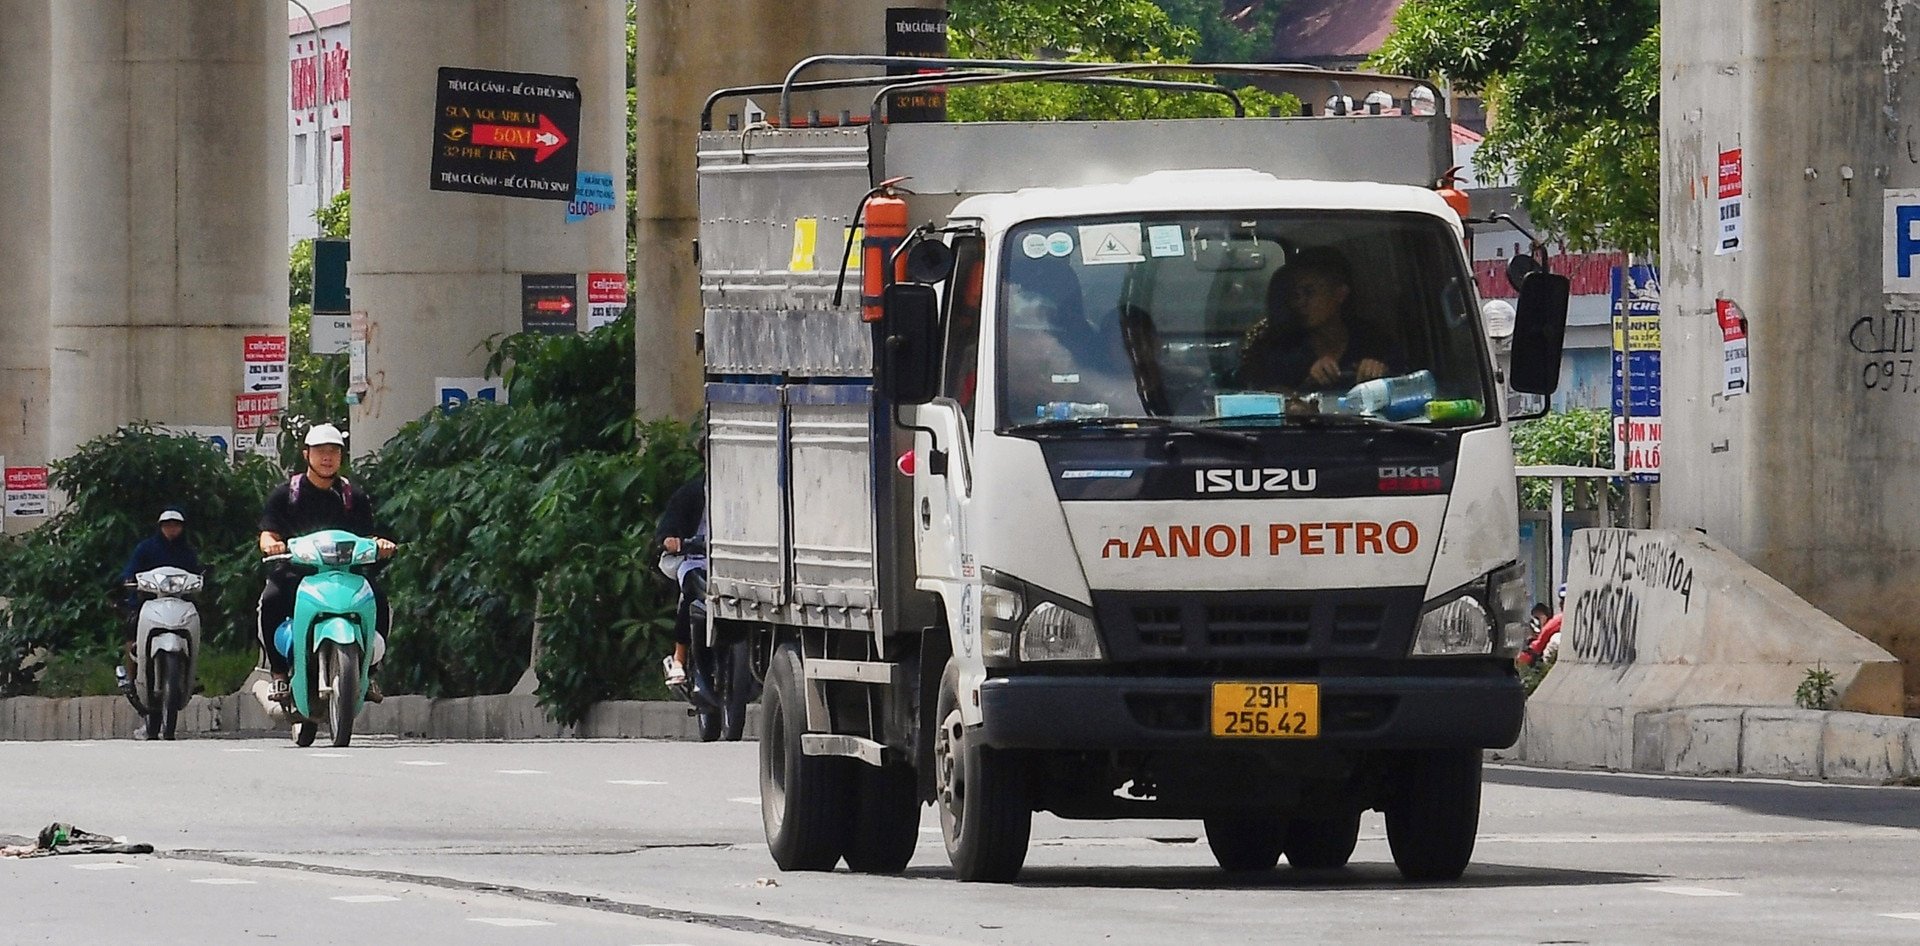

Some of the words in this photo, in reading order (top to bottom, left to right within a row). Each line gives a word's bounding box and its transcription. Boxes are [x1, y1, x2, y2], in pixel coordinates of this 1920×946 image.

[448, 79, 467, 91] TIỆM
[481, 80, 505, 94] CẢNH
[557, 89, 575, 100] SINH
[446, 106, 470, 118] SUN
[493, 127, 531, 144] 50M
[441, 171, 459, 183] TIỆM
[473, 172, 498, 186] CẢNH
[550, 181, 570, 192] SINH
[1614, 302, 1661, 312] MICHE
[1195, 468, 1316, 493] ISUZU
[1269, 520, 1420, 557] PETRO
[1243, 685, 1288, 708] 29H
[1224, 711, 1307, 734] 256.42
